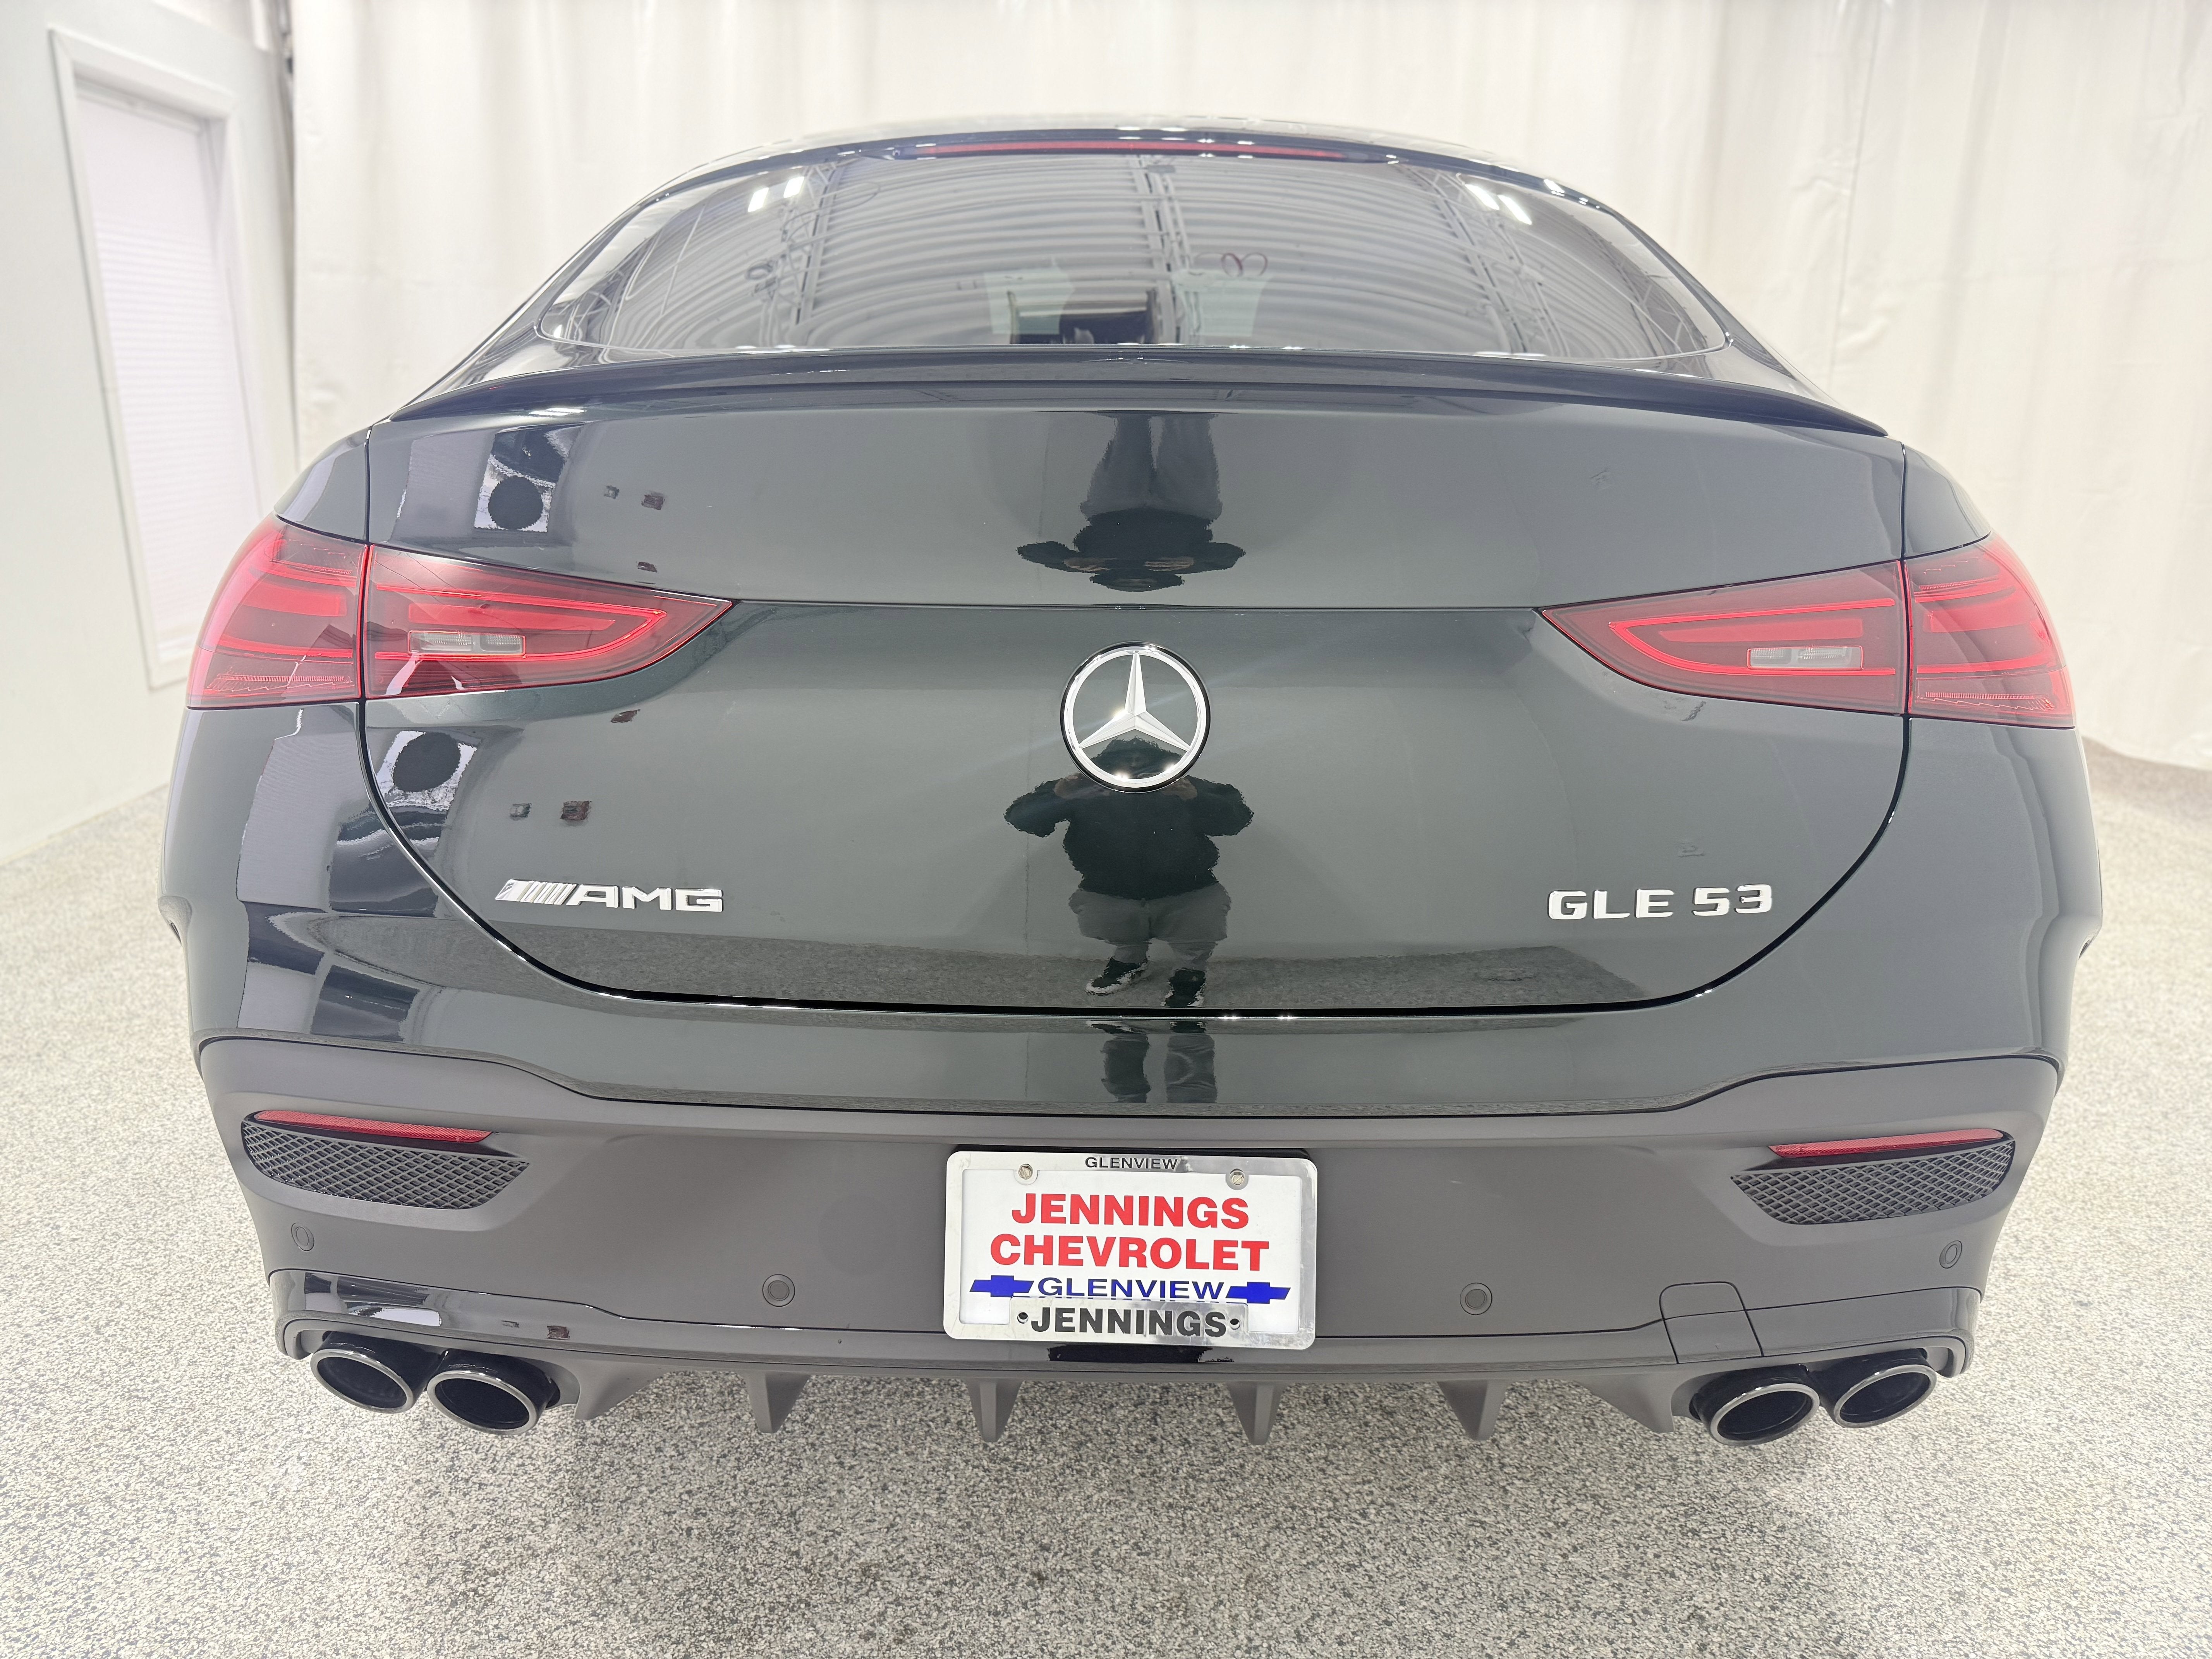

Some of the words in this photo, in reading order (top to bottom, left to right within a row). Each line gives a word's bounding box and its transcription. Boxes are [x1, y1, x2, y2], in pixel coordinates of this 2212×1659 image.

[566, 884, 723, 912] AMG
[1548, 888, 1674, 920] GLE
[1692, 884, 1772, 916] 53
[1085, 1157, 1178, 1170] GLENVIEW
[1012, 1193, 1249, 1229] JENNINGS
[990, 1233, 1269, 1271] CHEVROLET
[1037, 1277, 1225, 1300] GLENVIEW
[1031, 1307, 1227, 1338] JENNINGS
